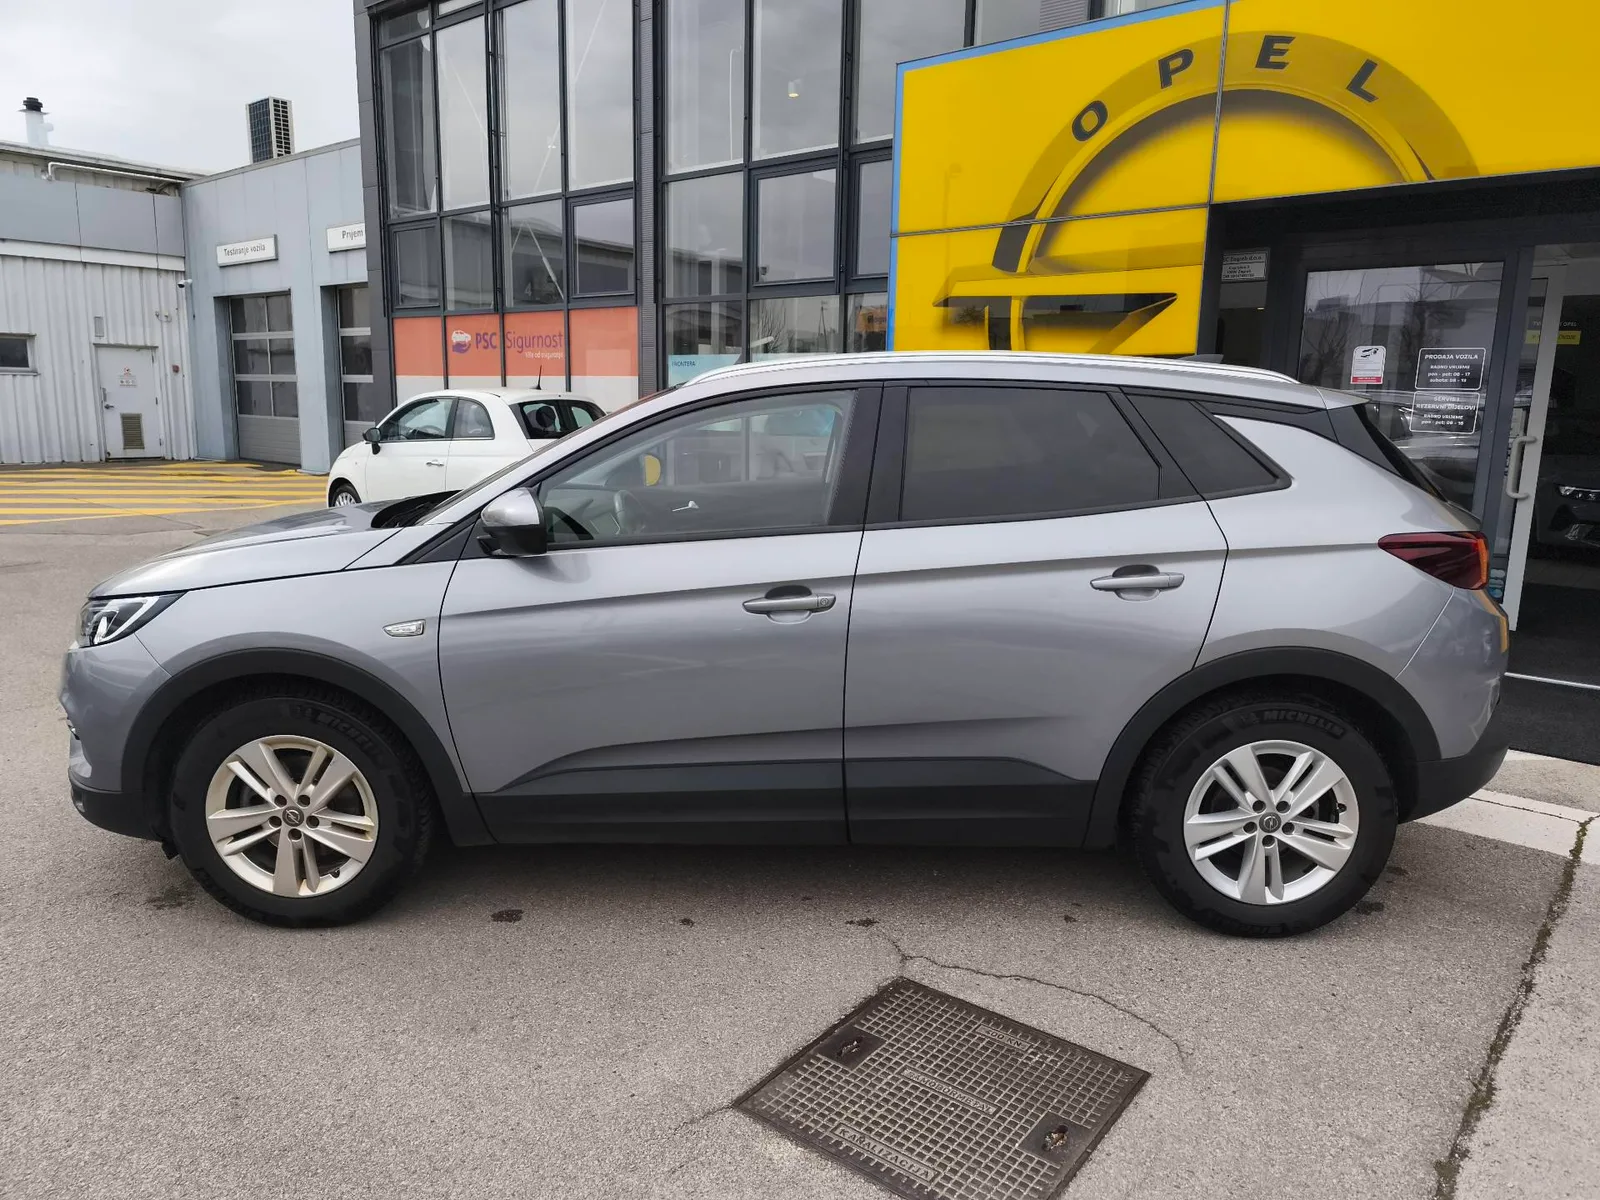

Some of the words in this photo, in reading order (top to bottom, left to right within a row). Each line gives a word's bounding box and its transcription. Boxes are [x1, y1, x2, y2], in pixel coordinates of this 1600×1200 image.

[1071, 34, 1379, 142] OPEL
[341, 229, 364, 241] Prijem
[223, 246, 249, 257] Testiranje
[250, 243, 266, 252] vozila
[475, 332, 498, 350] PSC
[505, 331, 563, 354] Sigurnost
[1263, 709, 1345, 737] MICHELIN
[839, 1128, 930, 1178] KANALIZACIJA
